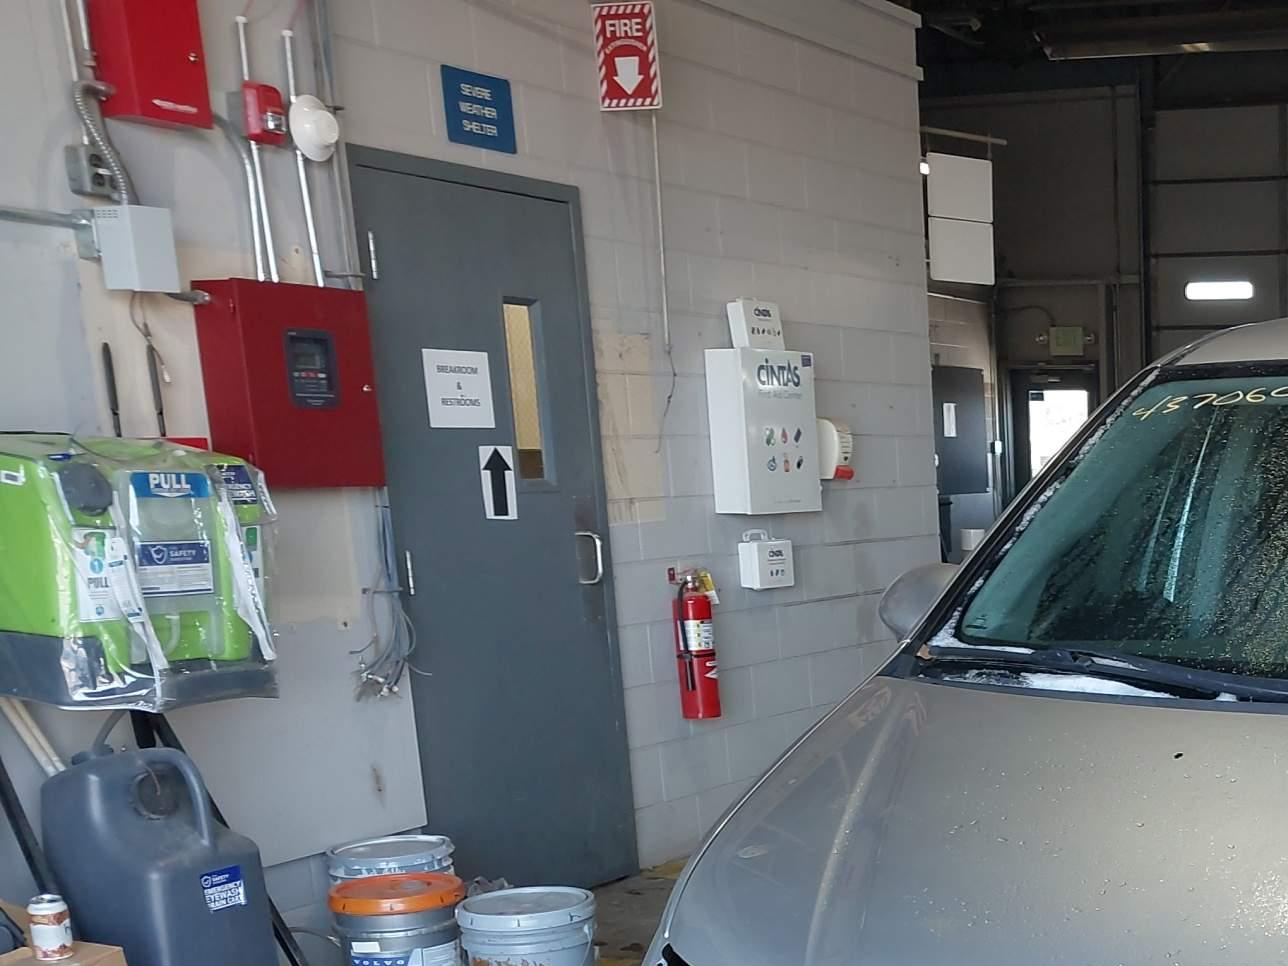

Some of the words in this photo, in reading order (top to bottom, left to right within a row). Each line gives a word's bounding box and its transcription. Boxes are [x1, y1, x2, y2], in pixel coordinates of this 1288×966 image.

[605, 18, 643, 38] FIRE
[460, 83, 492, 101] SEVERE
[458, 101, 498, 120] WEATHER
[462, 119, 498, 137] SHELTER
[436, 364, 478, 375] BREAKROOM
[757, 357, 801, 387] CINTAS
[441, 397, 481, 407] RESTROOMS
[148, 473, 191, 490] PULL
[169, 549, 197, 558] SAFETY
[87, 576, 110, 590] PULL
[353, 958, 405, 966] VOLVO
